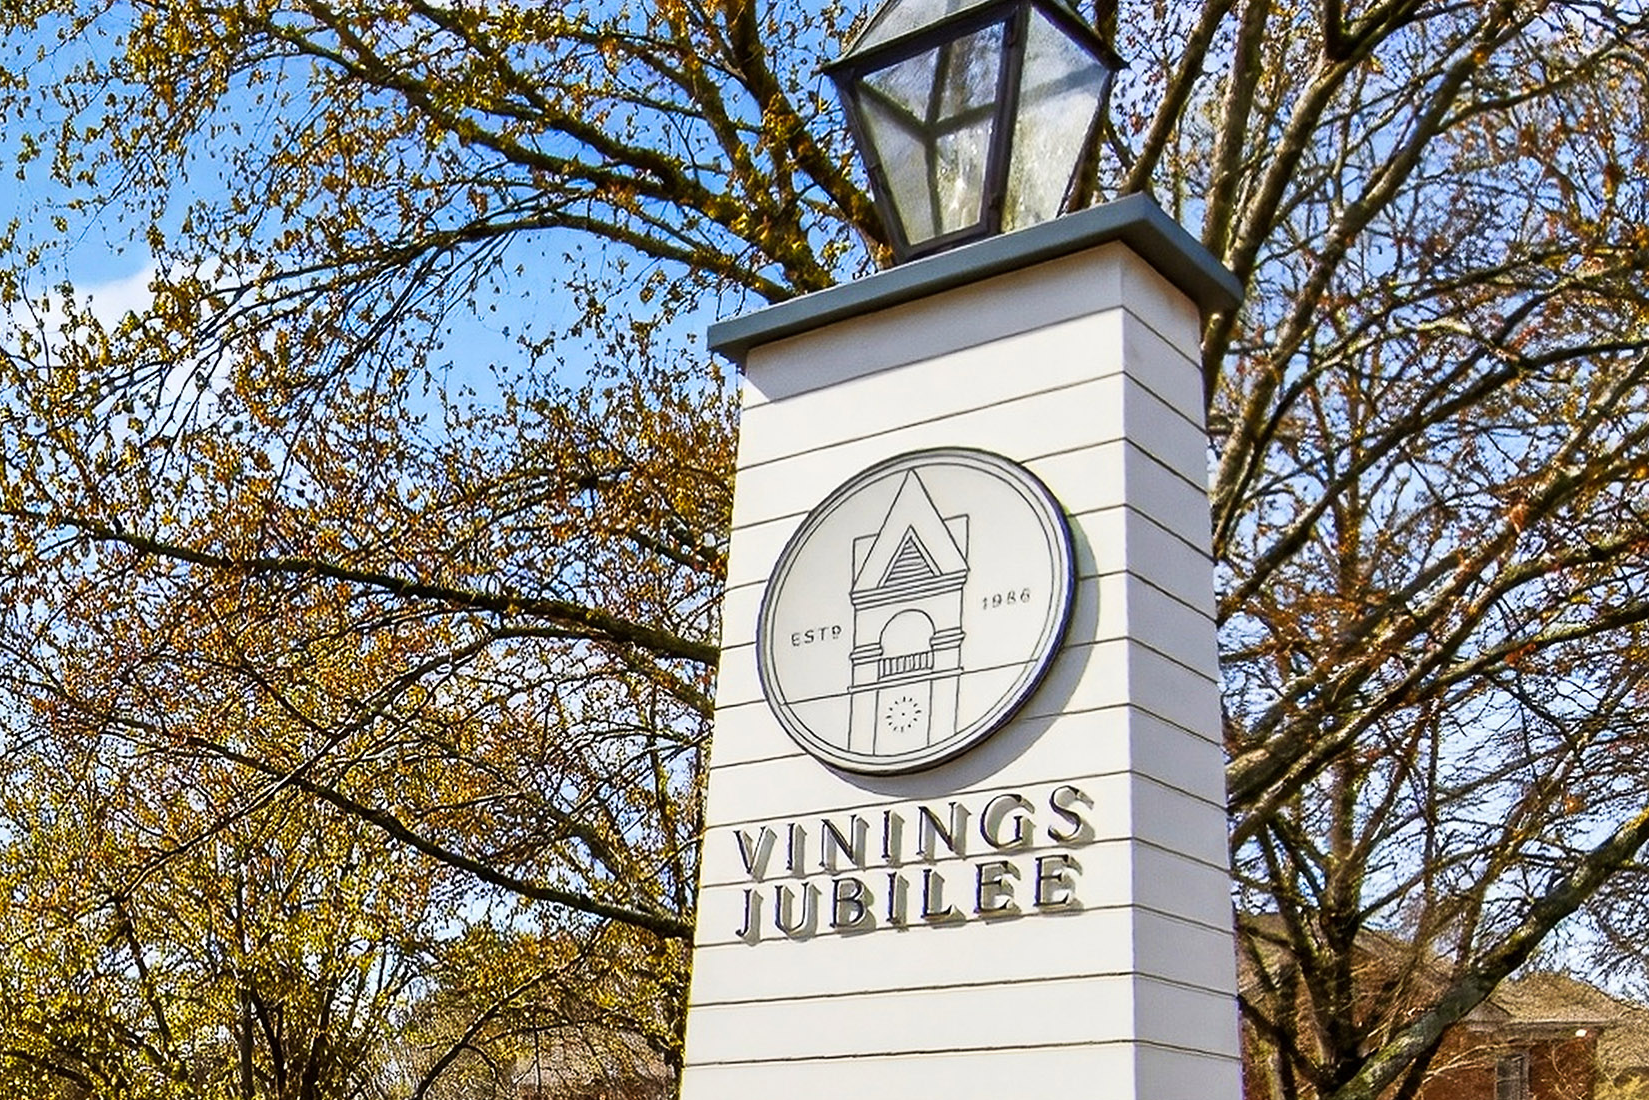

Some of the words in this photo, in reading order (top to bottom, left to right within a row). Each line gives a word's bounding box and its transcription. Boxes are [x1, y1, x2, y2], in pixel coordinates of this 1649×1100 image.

[982, 587, 1031, 610] 1986
[733, 785, 1094, 882] VININGS
[735, 854, 1084, 946] JUBILEE
